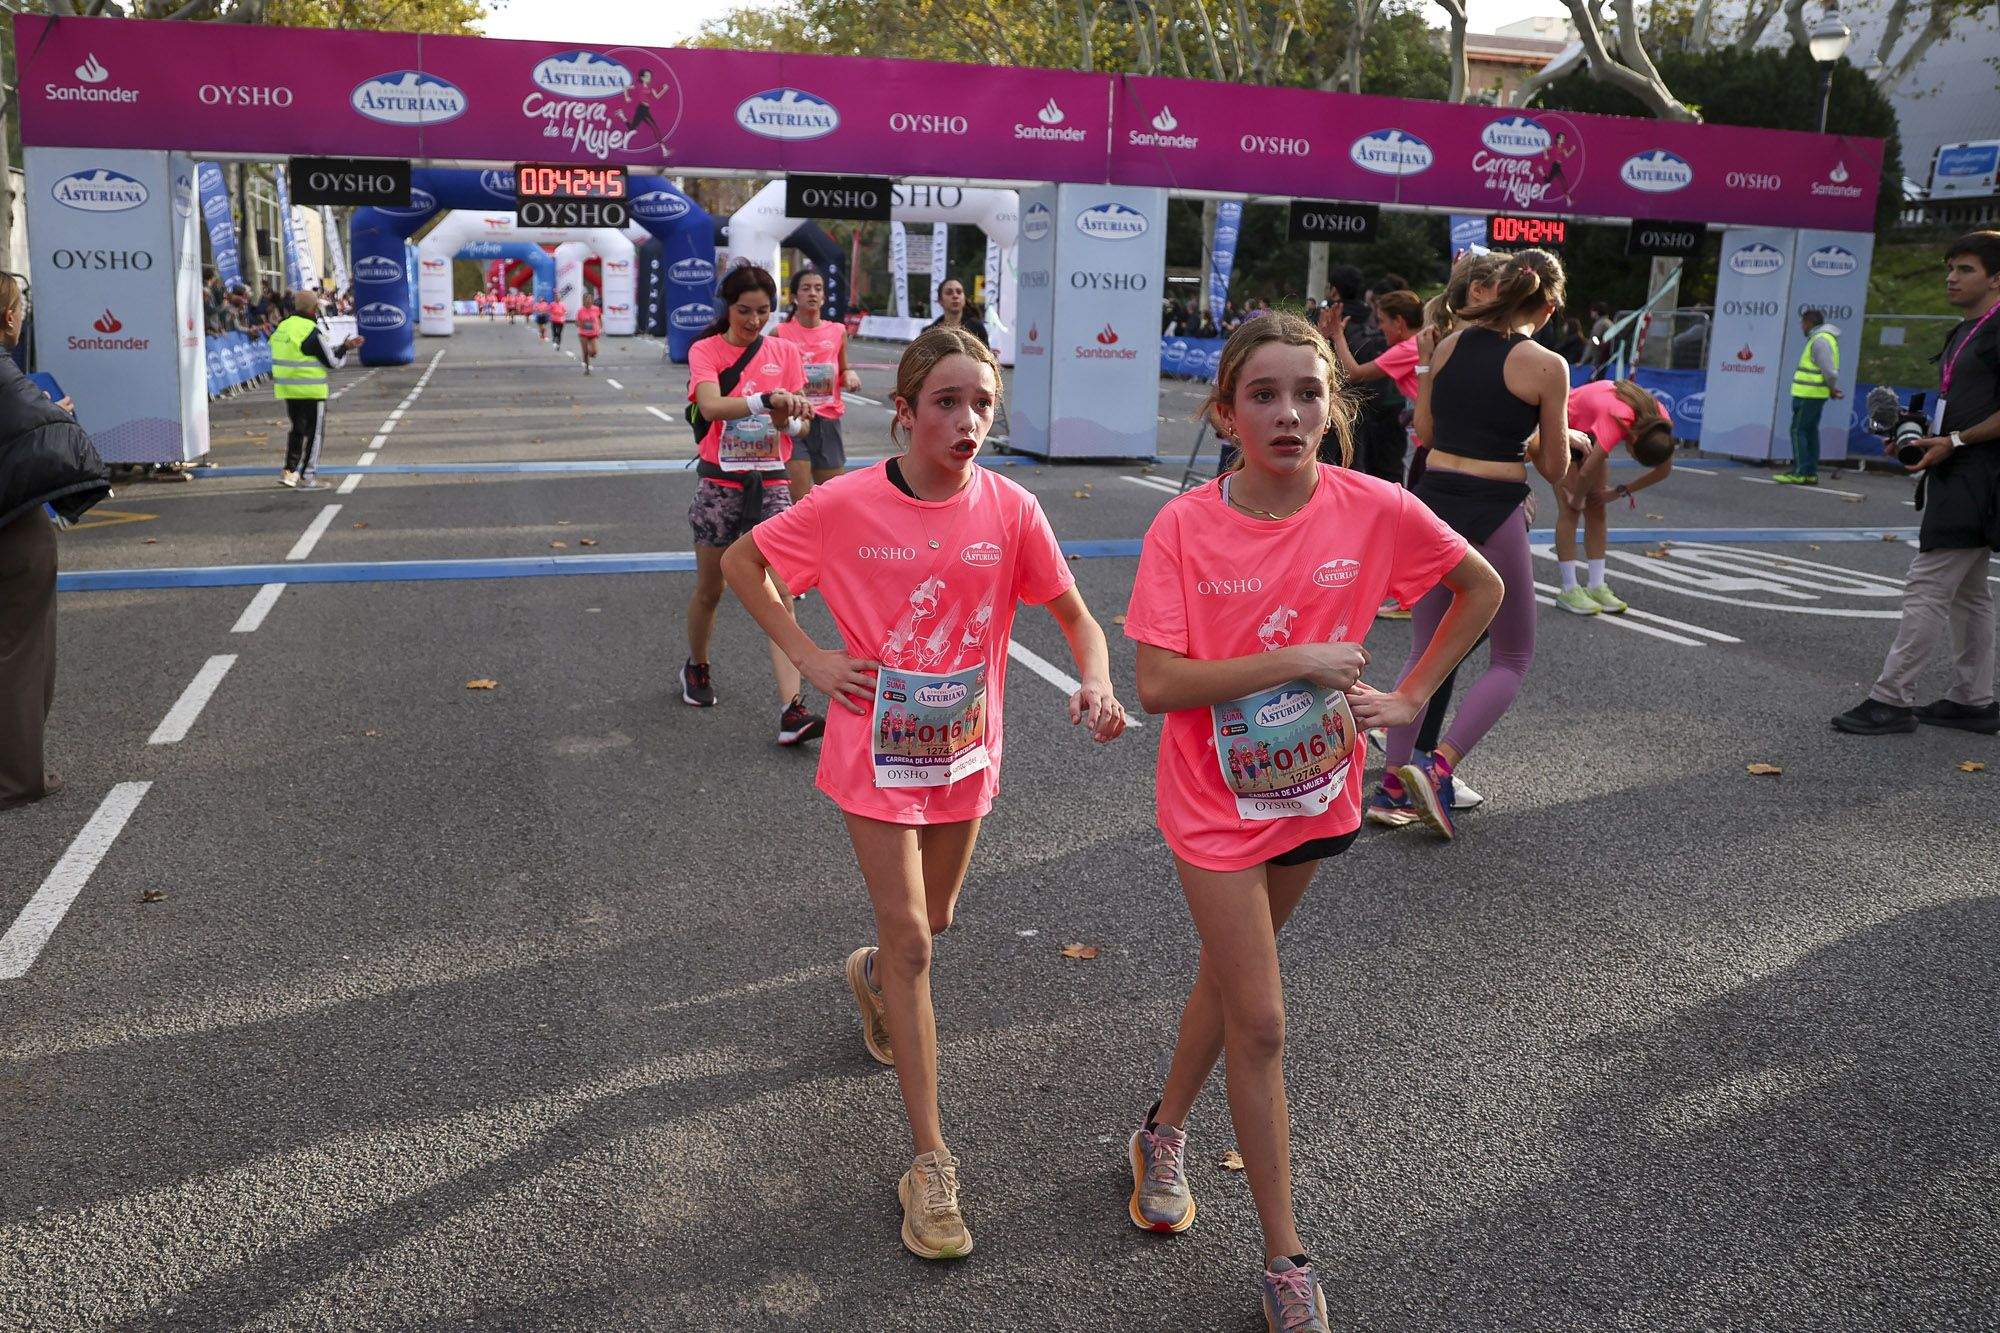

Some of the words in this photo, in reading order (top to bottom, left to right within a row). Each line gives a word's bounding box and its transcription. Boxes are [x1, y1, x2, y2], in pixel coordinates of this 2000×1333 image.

[541, 67, 625, 88] ASTURIANA
[45, 83, 140, 104] Santander
[199, 84, 293, 107] OYSHO
[360, 90, 458, 111] ASTURIANA
[523, 92, 607, 121] Carrera
[744, 105, 832, 127] ASTURIANA
[890, 112, 968, 135] OYSHO
[1014, 123, 1086, 141] Santander
[543, 119, 560, 138] de
[562, 119, 574, 138] la
[571, 120, 638, 160] Mujer
[1129, 130, 1198, 150] Santander
[1240, 134, 1310, 157] OYSHO
[1487, 129, 1546, 147] ASTURIANA
[1357, 144, 1427, 165] ASTURIANA
[1472, 151, 1532, 175] Carrera
[309, 172, 395, 194] OYSHO
[1627, 165, 1688, 183] ASTURIANA
[1725, 171, 1782, 191] OYSHO
[60, 184, 142, 202] ASTURIANA
[803, 188, 878, 209] OYSHO
[891, 185, 963, 208] SHO
[1503, 173, 1552, 208] Mujer
[1811, 181, 1863, 197] Santander
[521, 202, 626, 226] OYSHO
[1081, 215, 1143, 232] ASTURIANA
[1302, 213, 1366, 232] OYSHO
[1640, 229, 1695, 247] OYSHO
[53, 249, 153, 270] OYSHO
[1071, 271, 1147, 291] OYSHO
[1723, 301, 1779, 317] OYSHO
[68, 336, 149, 350] Santander
[1076, 346, 1137, 360] Santander
[859, 546, 916, 560] OYSHO
[1197, 578, 1262, 595] OYSHO
[918, 689, 965, 702] ASTURIANA
[1261, 698, 1312, 724] ASTURIANA
[918, 720, 962, 743] 016
[885, 756, 915, 764] CARRERA
[915, 757, 924, 765] DE
[1273, 735, 1326, 771] 016
[887, 769, 929, 780] OYSHO
[1290, 765, 1322, 784] 12746
[1281, 788, 1291, 797] DE
[1291, 786, 1303, 796] LA
[1302, 777, 1325, 791] MUJER
[1255, 801, 1302, 812] OYSHO
